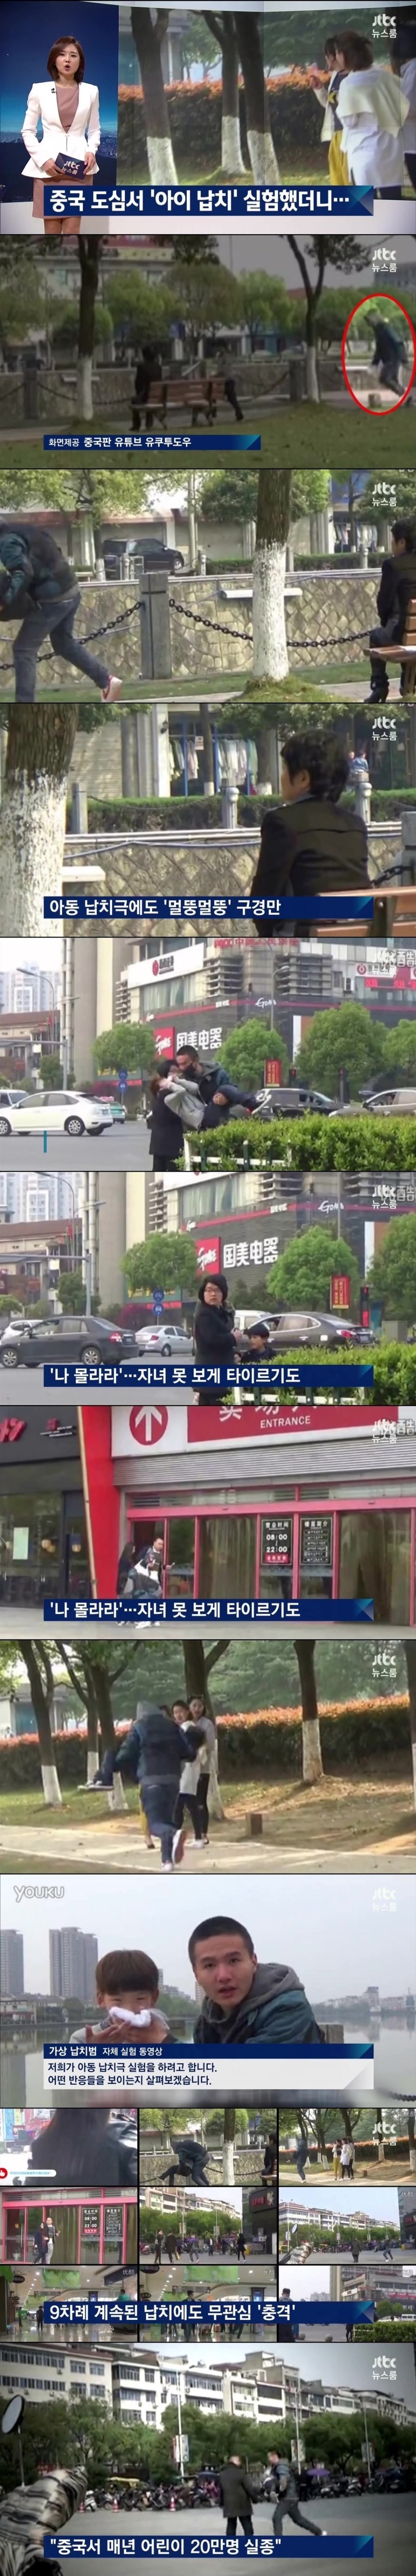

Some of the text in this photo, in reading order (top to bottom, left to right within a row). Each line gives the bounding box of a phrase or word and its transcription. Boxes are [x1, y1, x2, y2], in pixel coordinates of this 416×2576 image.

[176, 1027, 222, 1051] 国美电器
[223, 1236, 279, 1269] 国美电器
[260, 1415, 311, 1429] ENTRANCE
